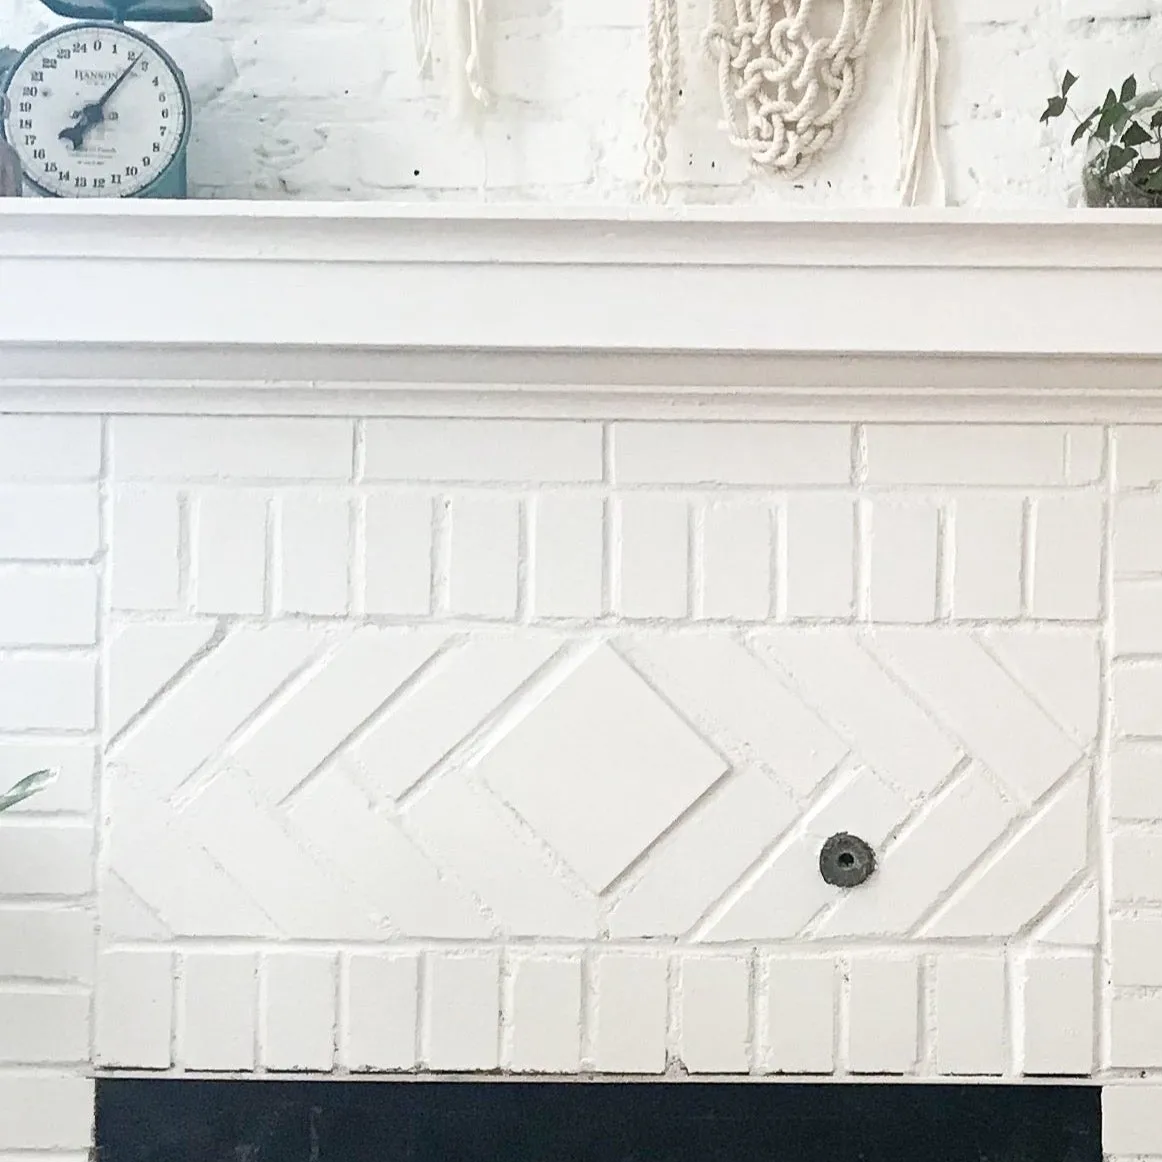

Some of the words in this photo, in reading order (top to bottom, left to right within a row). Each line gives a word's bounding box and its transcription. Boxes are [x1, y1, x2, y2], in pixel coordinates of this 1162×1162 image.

[94, 40, 102, 51] 0
[112, 44, 118, 54] 1
[152, 76, 159, 86] 4
[20, 102, 32, 112] 19
[162, 108, 168, 119] 6
[19, 119, 32, 130] 18
[160, 126, 166, 136] 7
[24, 134, 36, 146] 17
[152, 142, 160, 152] 8
[142, 156, 150, 166] 9
[58, 170, 70, 182] 14
[126, 166, 138, 177] 10
[74, 177, 87, 188] 13
[92, 178, 105, 188] 12
[111, 174, 122, 184] 11
